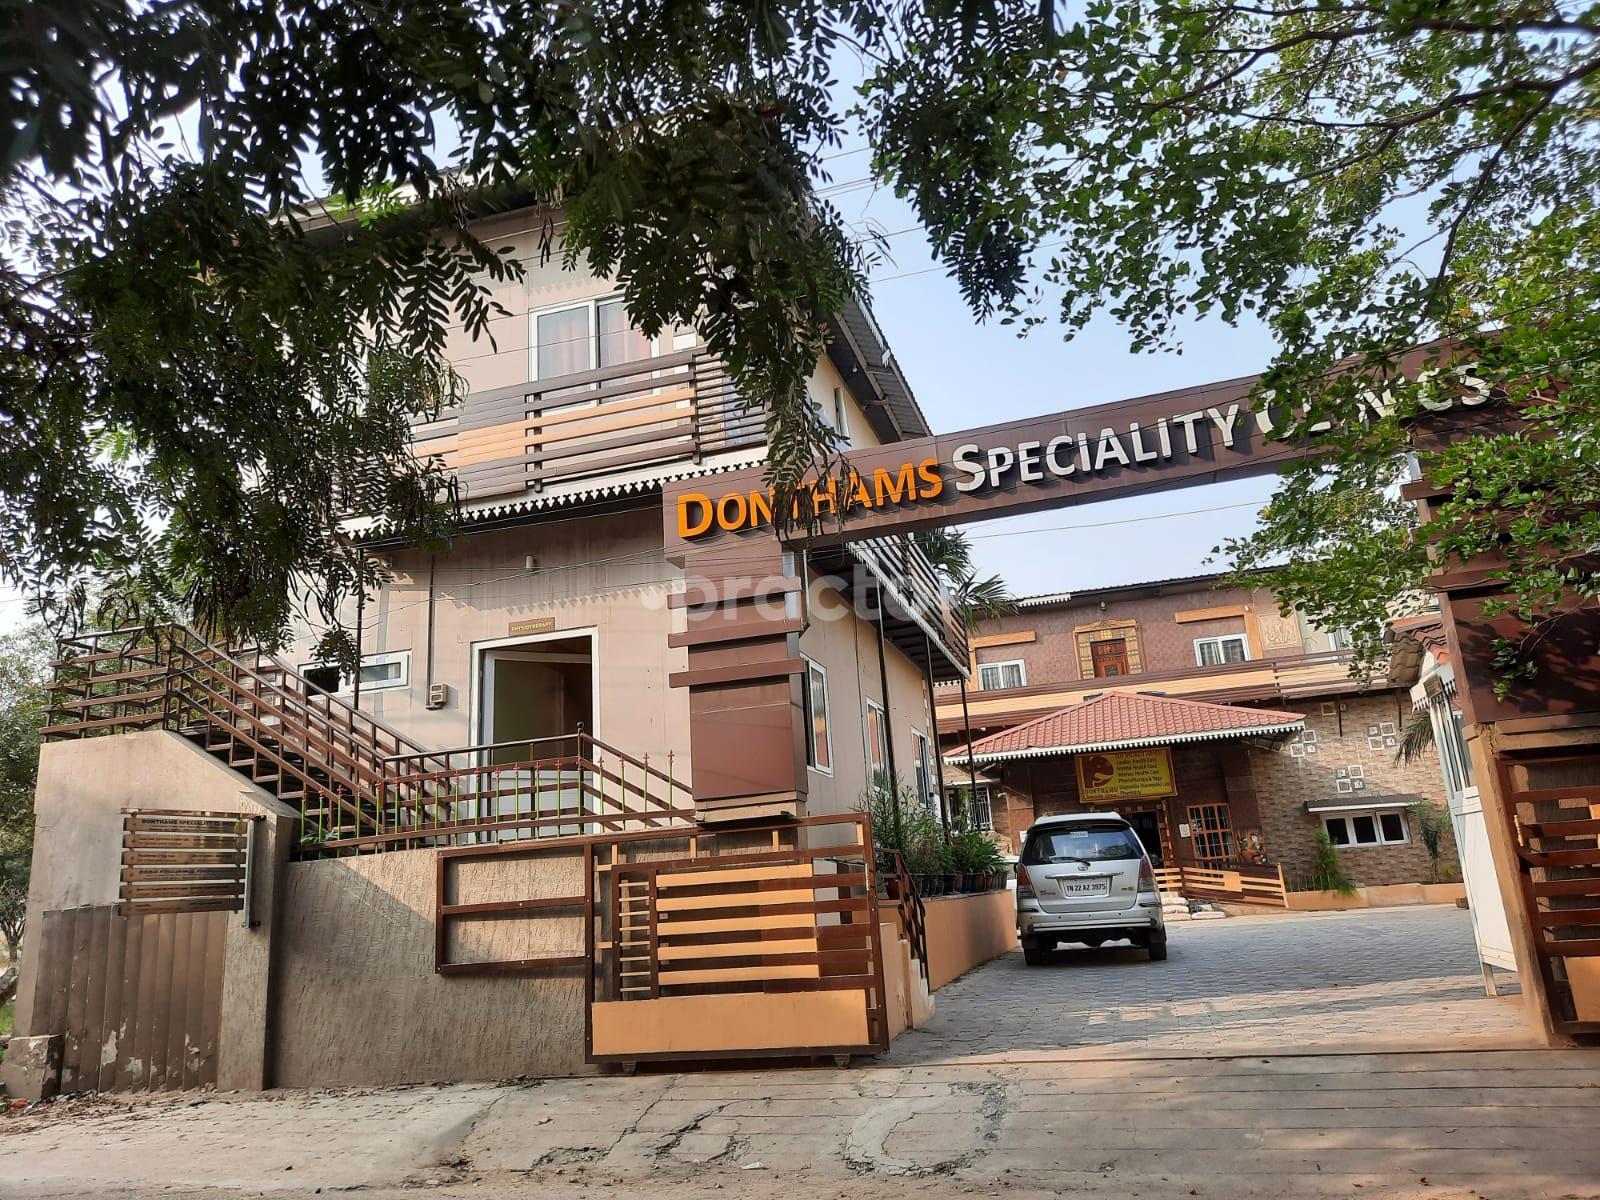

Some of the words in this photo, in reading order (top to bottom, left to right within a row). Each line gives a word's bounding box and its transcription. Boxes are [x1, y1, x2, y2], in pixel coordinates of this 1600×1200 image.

[678, 458, 943, 537] DONHAMS
[952, 404, 1239, 492] SPECIALITY
[1255, 362, 1490, 438] CNCS
